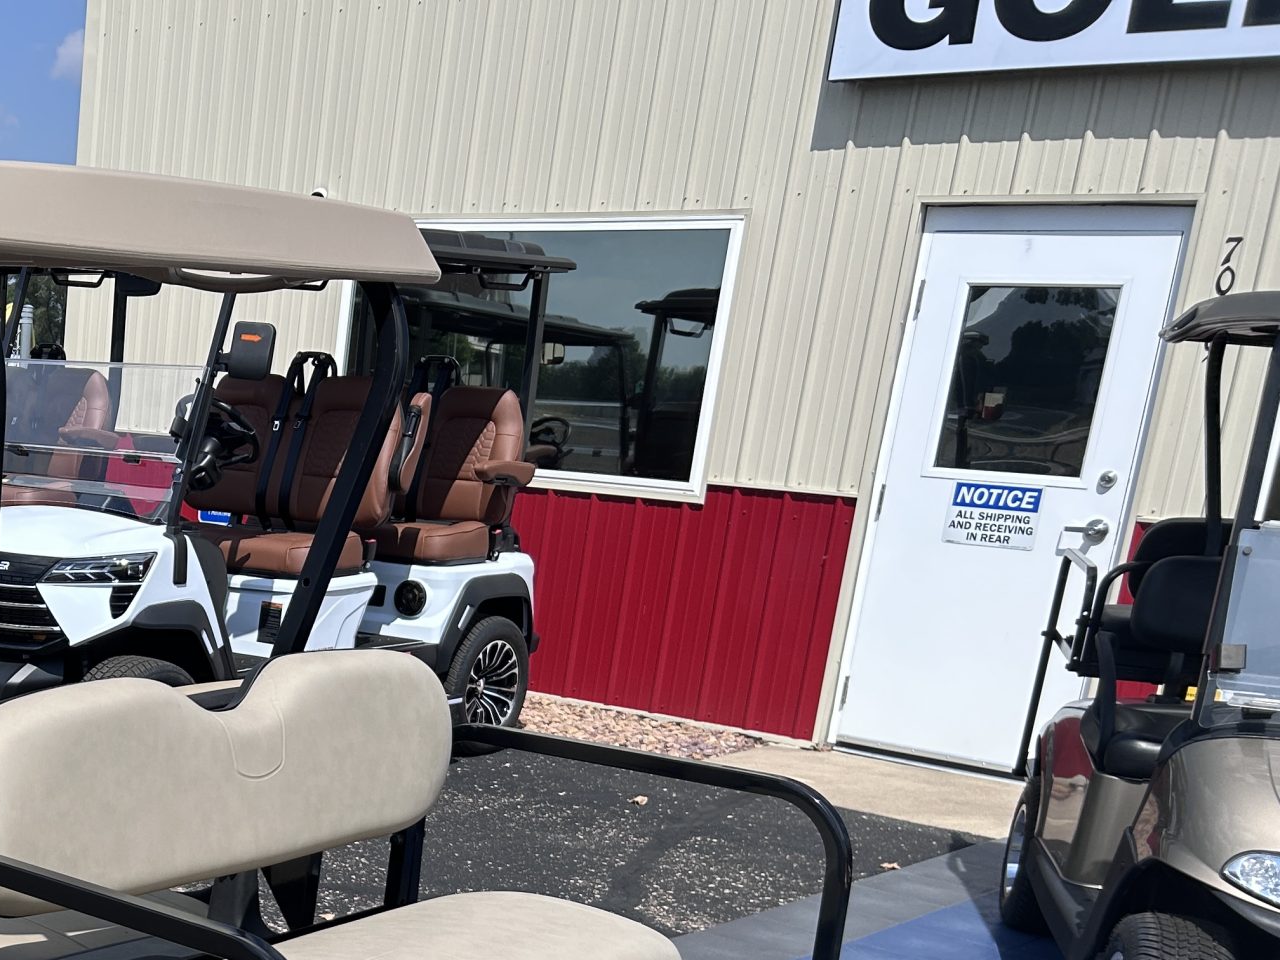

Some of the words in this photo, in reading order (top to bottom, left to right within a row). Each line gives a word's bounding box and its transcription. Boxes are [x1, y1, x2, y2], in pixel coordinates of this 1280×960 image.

[956, 486, 1038, 509] NOTICE
[955, 509, 976, 520] ALL
[978, 511, 1031, 525] SHIPPING
[948, 520, 972, 530] AND
[974, 522, 1034, 536] RECEIVING
[966, 532, 977, 541] IN
[980, 533, 1011, 545] REAR
